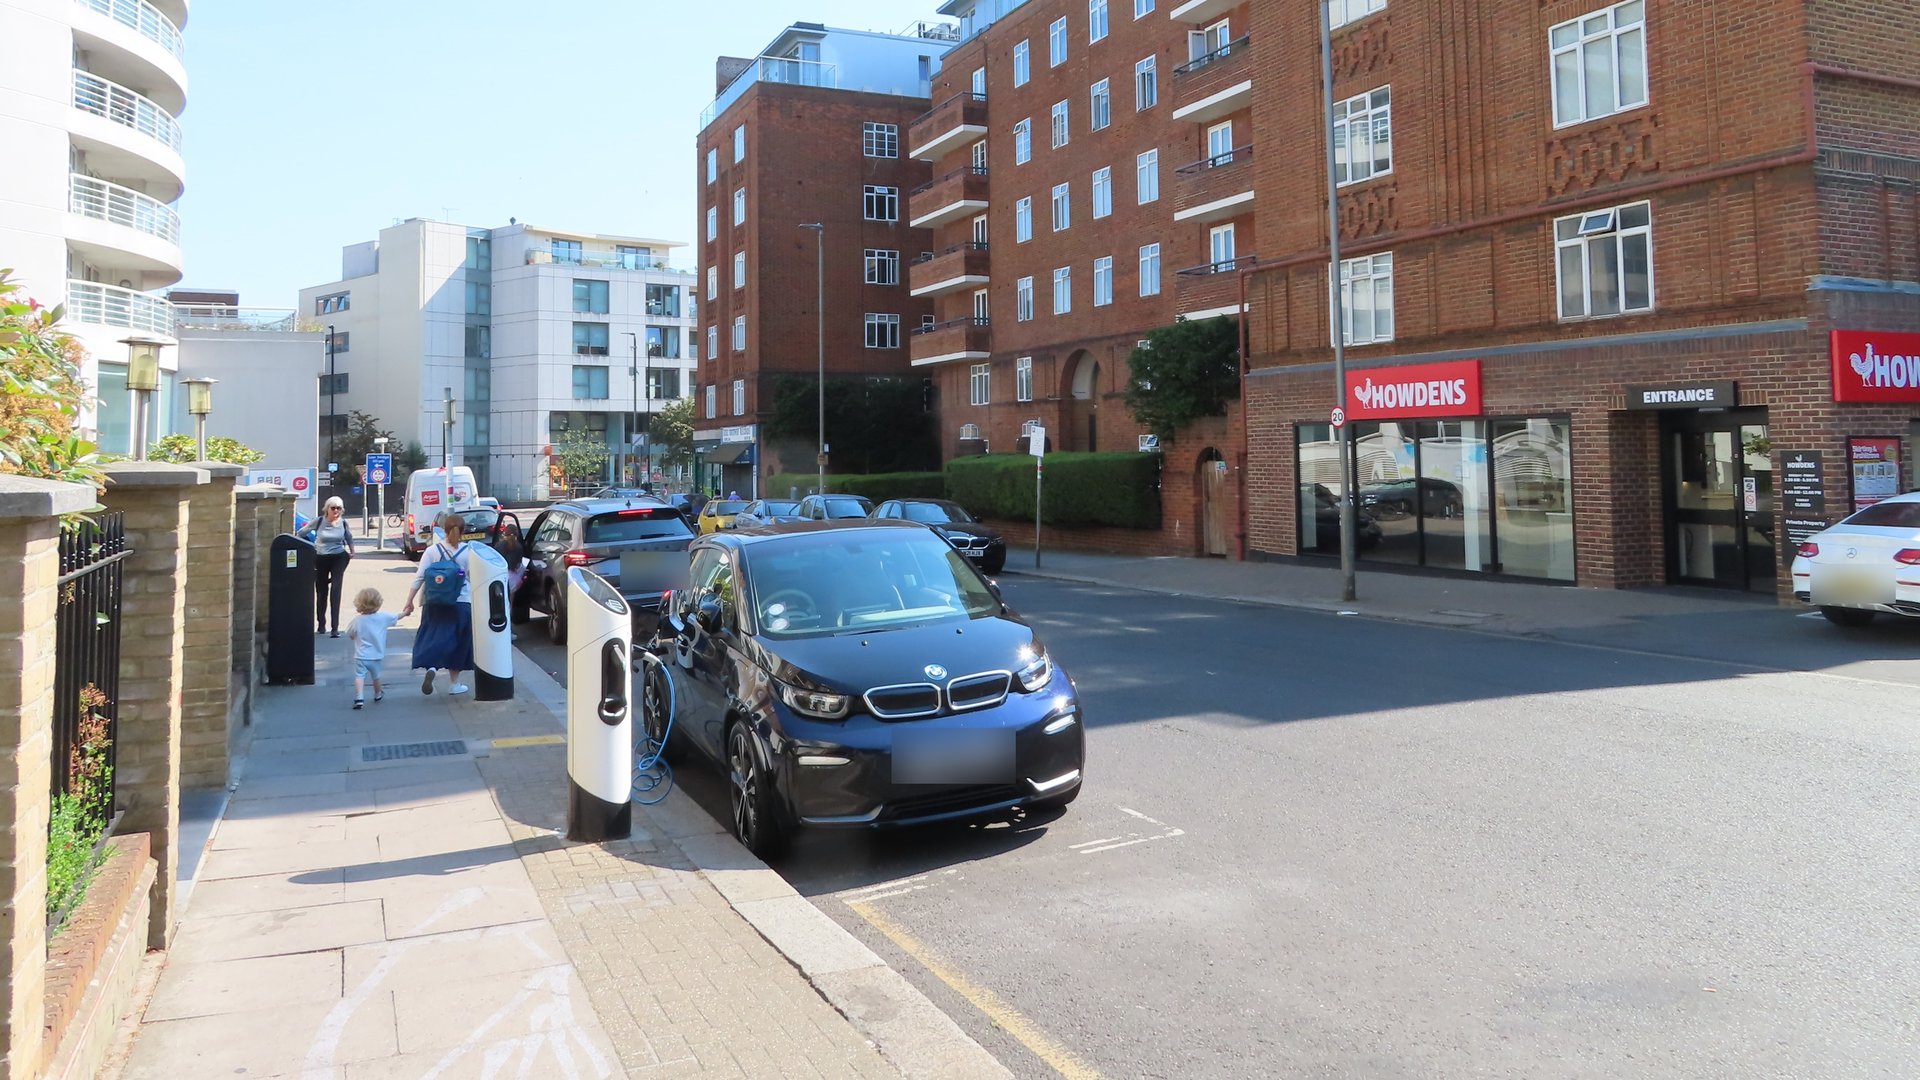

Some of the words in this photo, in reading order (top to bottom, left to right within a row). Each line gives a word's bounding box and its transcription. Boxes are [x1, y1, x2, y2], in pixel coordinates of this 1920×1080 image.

[1874, 354, 1920, 388] HOW
[1371, 379, 1467, 409] HOWDENS
[1643, 388, 1714, 404] ENTRANCE
[1332, 412, 1344, 422] 20
